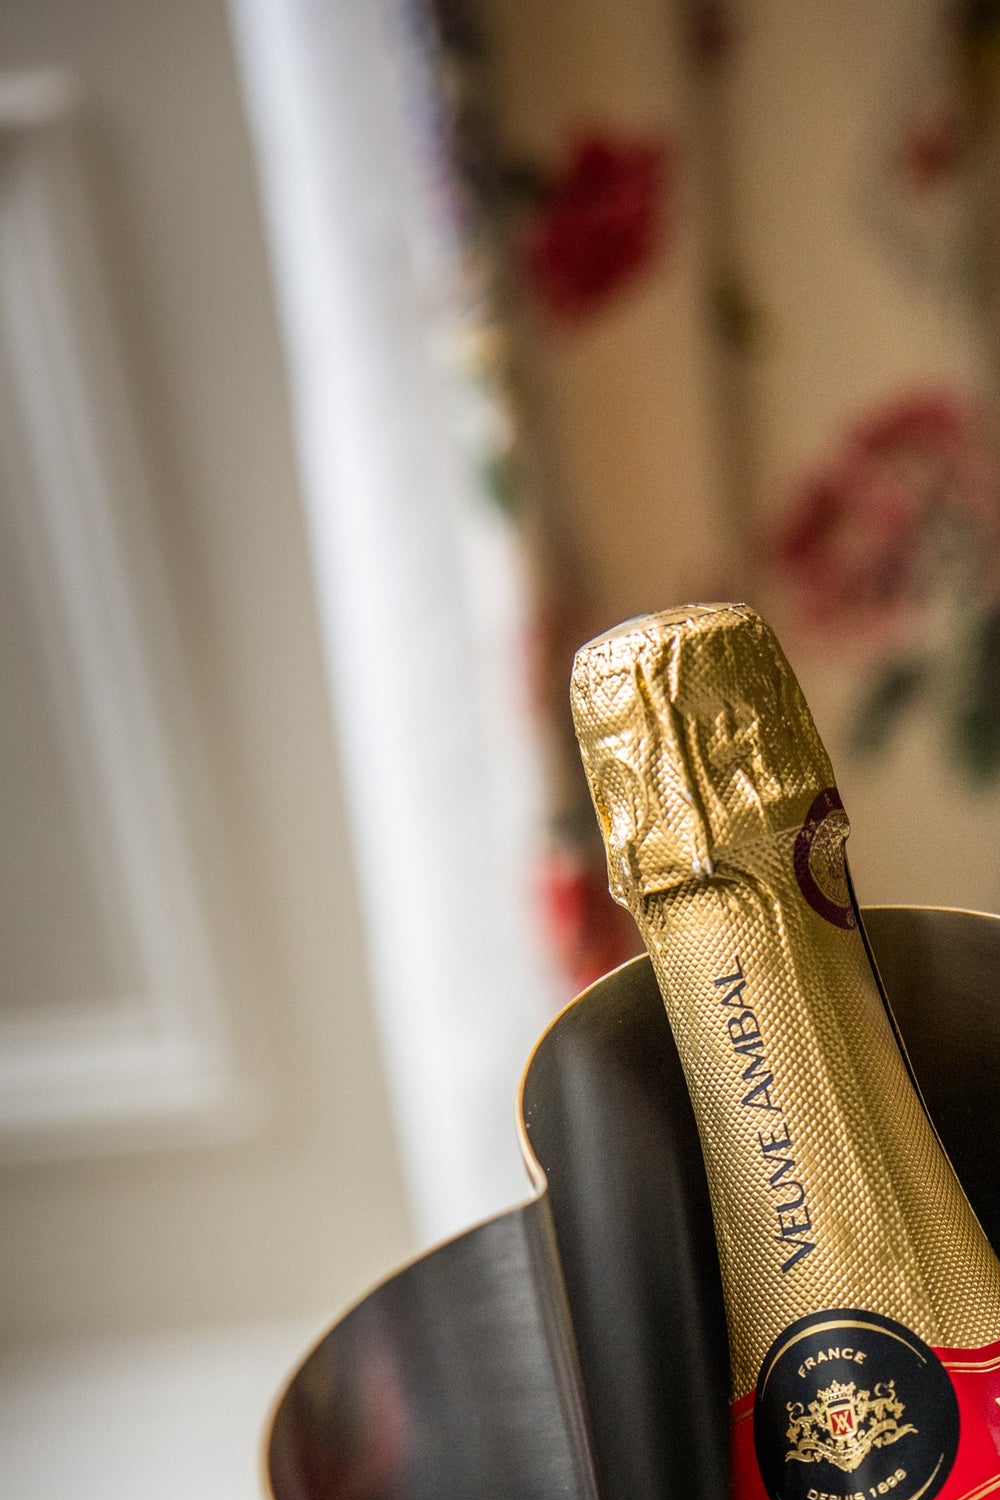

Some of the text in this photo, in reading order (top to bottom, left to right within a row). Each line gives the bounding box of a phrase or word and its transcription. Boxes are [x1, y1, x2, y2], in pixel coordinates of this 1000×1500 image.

[713, 955, 816, 1273] VEUVE AMBAL
[797, 1347, 867, 1378] FRANCE
[868, 1468, 907, 1498] 1898
